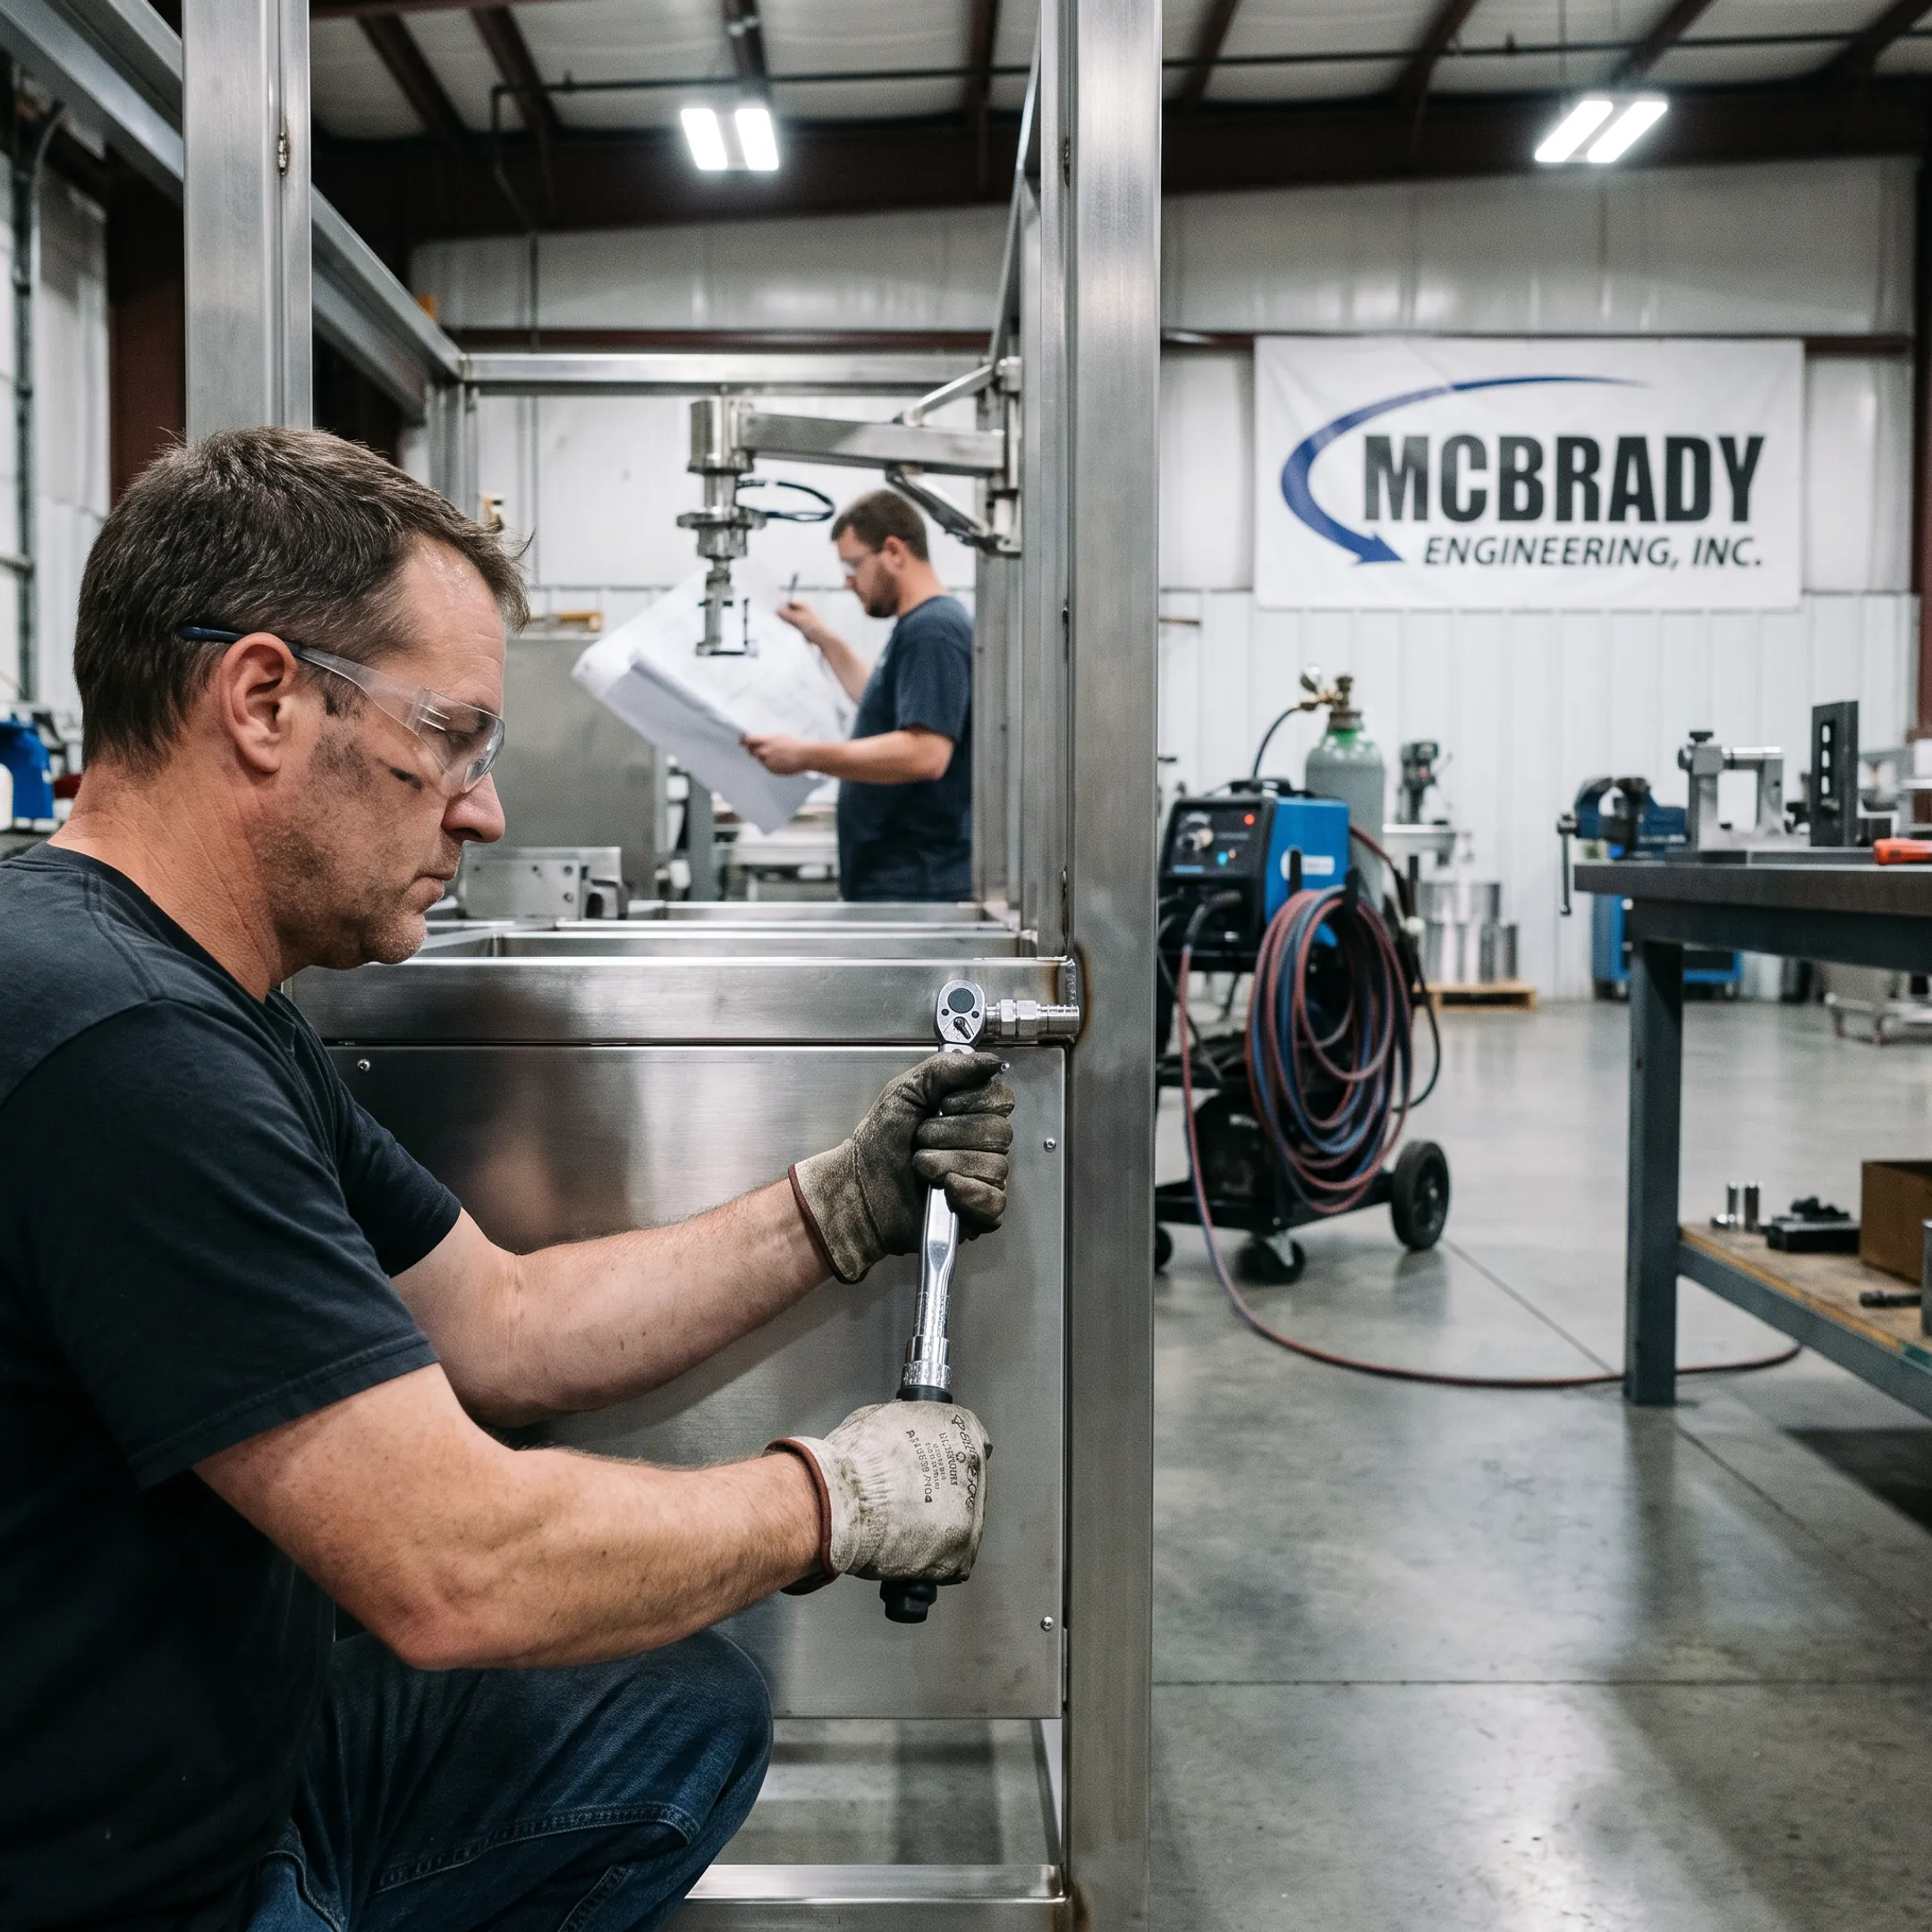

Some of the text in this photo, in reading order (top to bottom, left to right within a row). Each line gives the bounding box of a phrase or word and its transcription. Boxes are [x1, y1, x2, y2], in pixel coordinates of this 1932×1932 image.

[1364, 435, 1765, 522] MCBRADY
[1424, 537, 1762, 569] ENGINEERING, INC.
